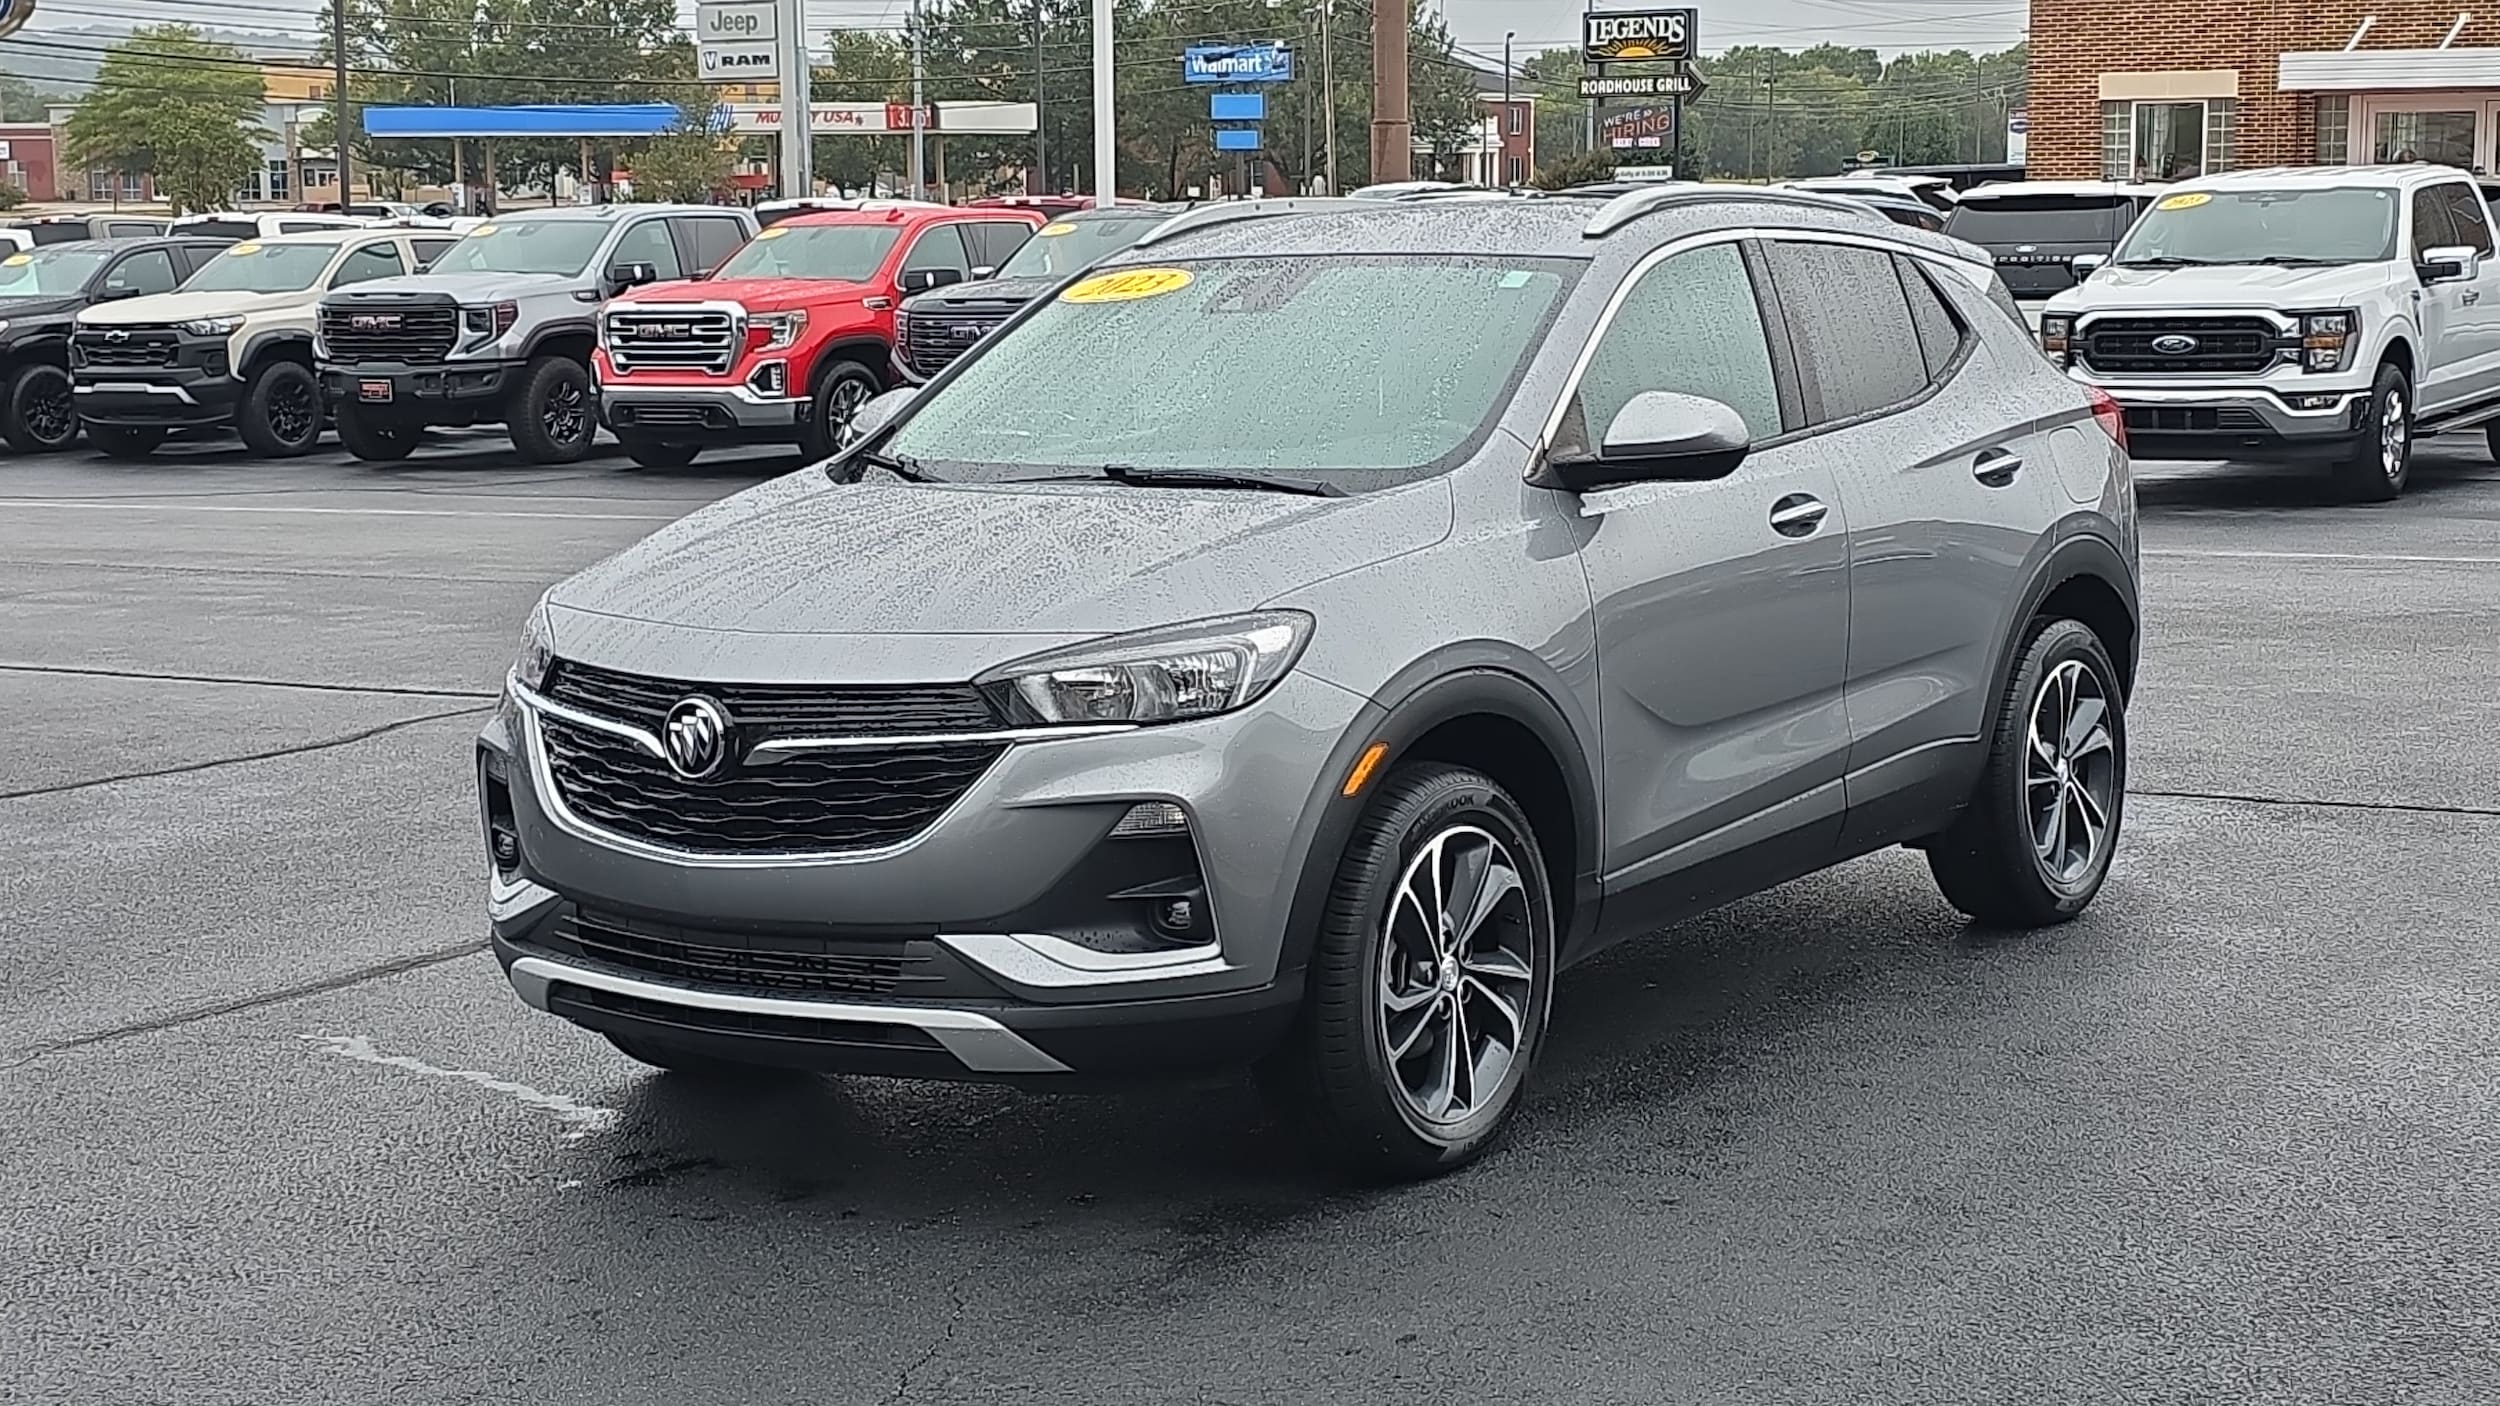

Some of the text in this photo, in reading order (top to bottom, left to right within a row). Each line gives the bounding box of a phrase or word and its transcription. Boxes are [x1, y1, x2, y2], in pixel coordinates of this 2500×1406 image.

[710, 10, 758, 35] Jeep
[1588, 16, 1685, 46] LEGENDS
[721, 55, 770, 66] RAM
[1191, 53, 1264, 73] Walmart
[1581, 77, 1692, 94] ROADHOUSE GRILL
[755, 111, 854, 124] MUY USA
[1603, 109, 1641, 128] WE'RE
[1603, 115, 1670, 143] HIRING
[1074, 274, 1178, 298] 2023
[638, 324, 690, 337] GMC
